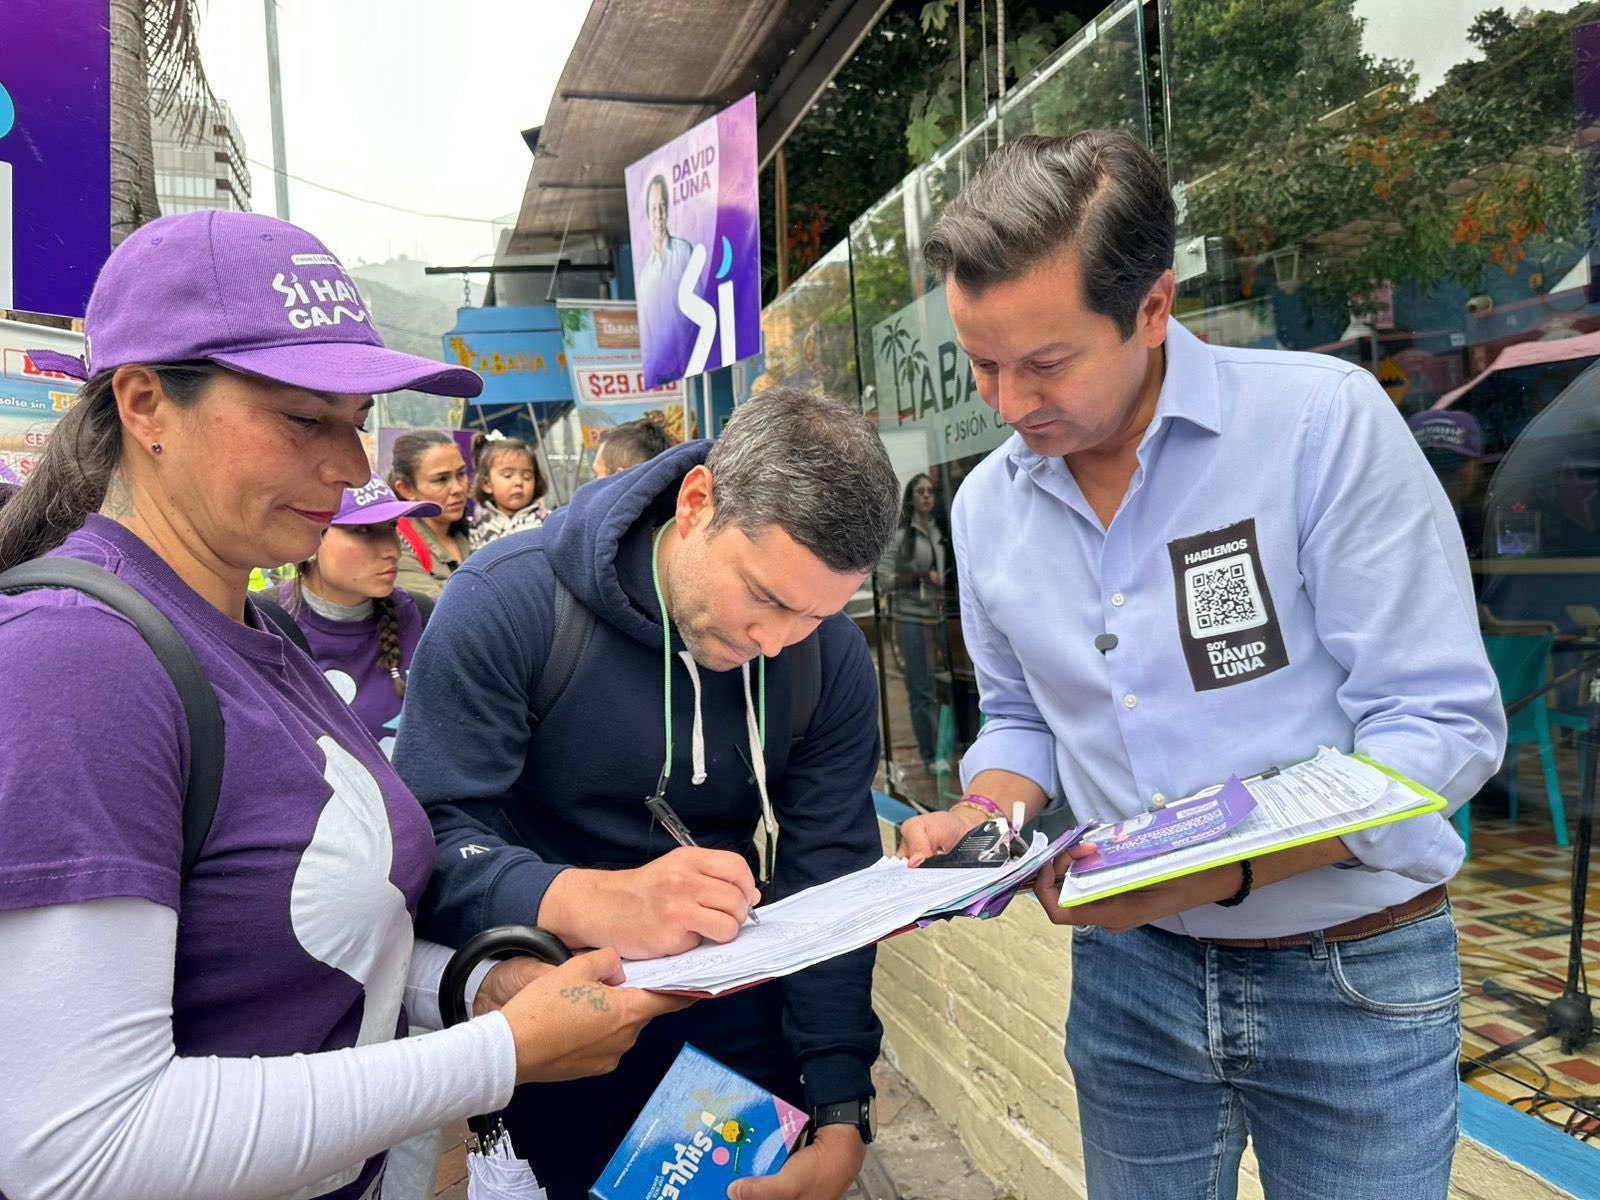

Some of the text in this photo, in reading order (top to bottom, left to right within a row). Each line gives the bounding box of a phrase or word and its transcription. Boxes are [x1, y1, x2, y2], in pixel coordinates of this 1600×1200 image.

[672, 145, 716, 184] DAVID
[672, 171, 711, 206] LUNA
[30, 400, 46, 409] sin
[1184, 538, 1248, 565] HABLEMOS
[1206, 640, 1227, 652] SOY
[1208, 641, 1266, 665] DAVID
[1212, 658, 1266, 680] LUNA
[656, 1130, 713, 1200] SHULE
